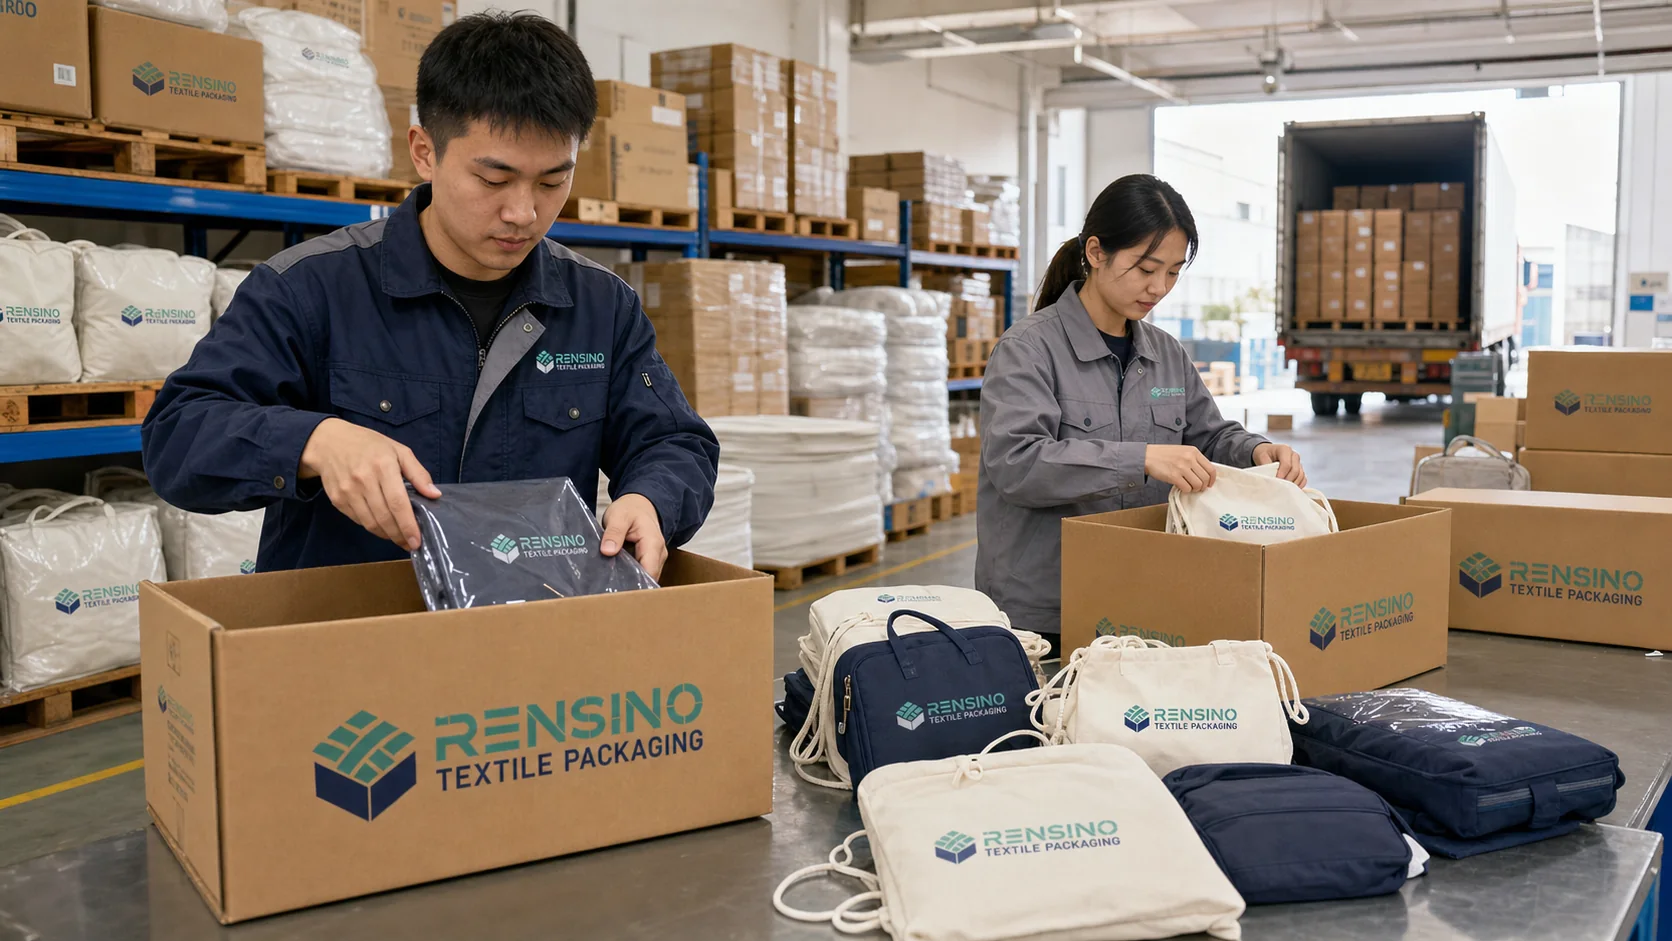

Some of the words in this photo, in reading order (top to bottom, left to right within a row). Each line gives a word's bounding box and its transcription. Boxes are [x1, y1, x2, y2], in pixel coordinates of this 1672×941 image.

[168, 70, 237, 94] RENSINO
[168, 86, 199, 98] TEXTILE
[6, 306, 60, 318] RENSINO
[555, 352, 605, 364] RENSINO
[1584, 393, 1652, 406] RENSINO
[1241, 516, 1295, 525] RENSINO
[519, 534, 585, 550] RENSINO
[1509, 561, 1643, 592] RENSINO
[1510, 583, 1563, 599] TEXTILE
[1568, 588, 1643, 607] PACKAGING
[1340, 591, 1414, 628] RENSINO
[1340, 623, 1372, 641] TEXTILE
[1374, 611, 1414, 632] PACKAGING
[927, 692, 1005, 716] RENSINO
[929, 712, 962, 724] TEXTILE
[964, 705, 1007, 719] PACKAGING
[1154, 708, 1237, 721] RENSINO
[435, 683, 703, 762] RENSINO
[1154, 722, 1188, 730] TEXTILE
[1191, 722, 1238, 730] PACKAGING
[436, 752, 553, 791] TEXTILE
[564, 729, 703, 772] PACKAGING
[983, 820, 1119, 847] RENSINO
[985, 844, 1040, 857] TEXTILE
[1045, 836, 1121, 852] PACKAGING
